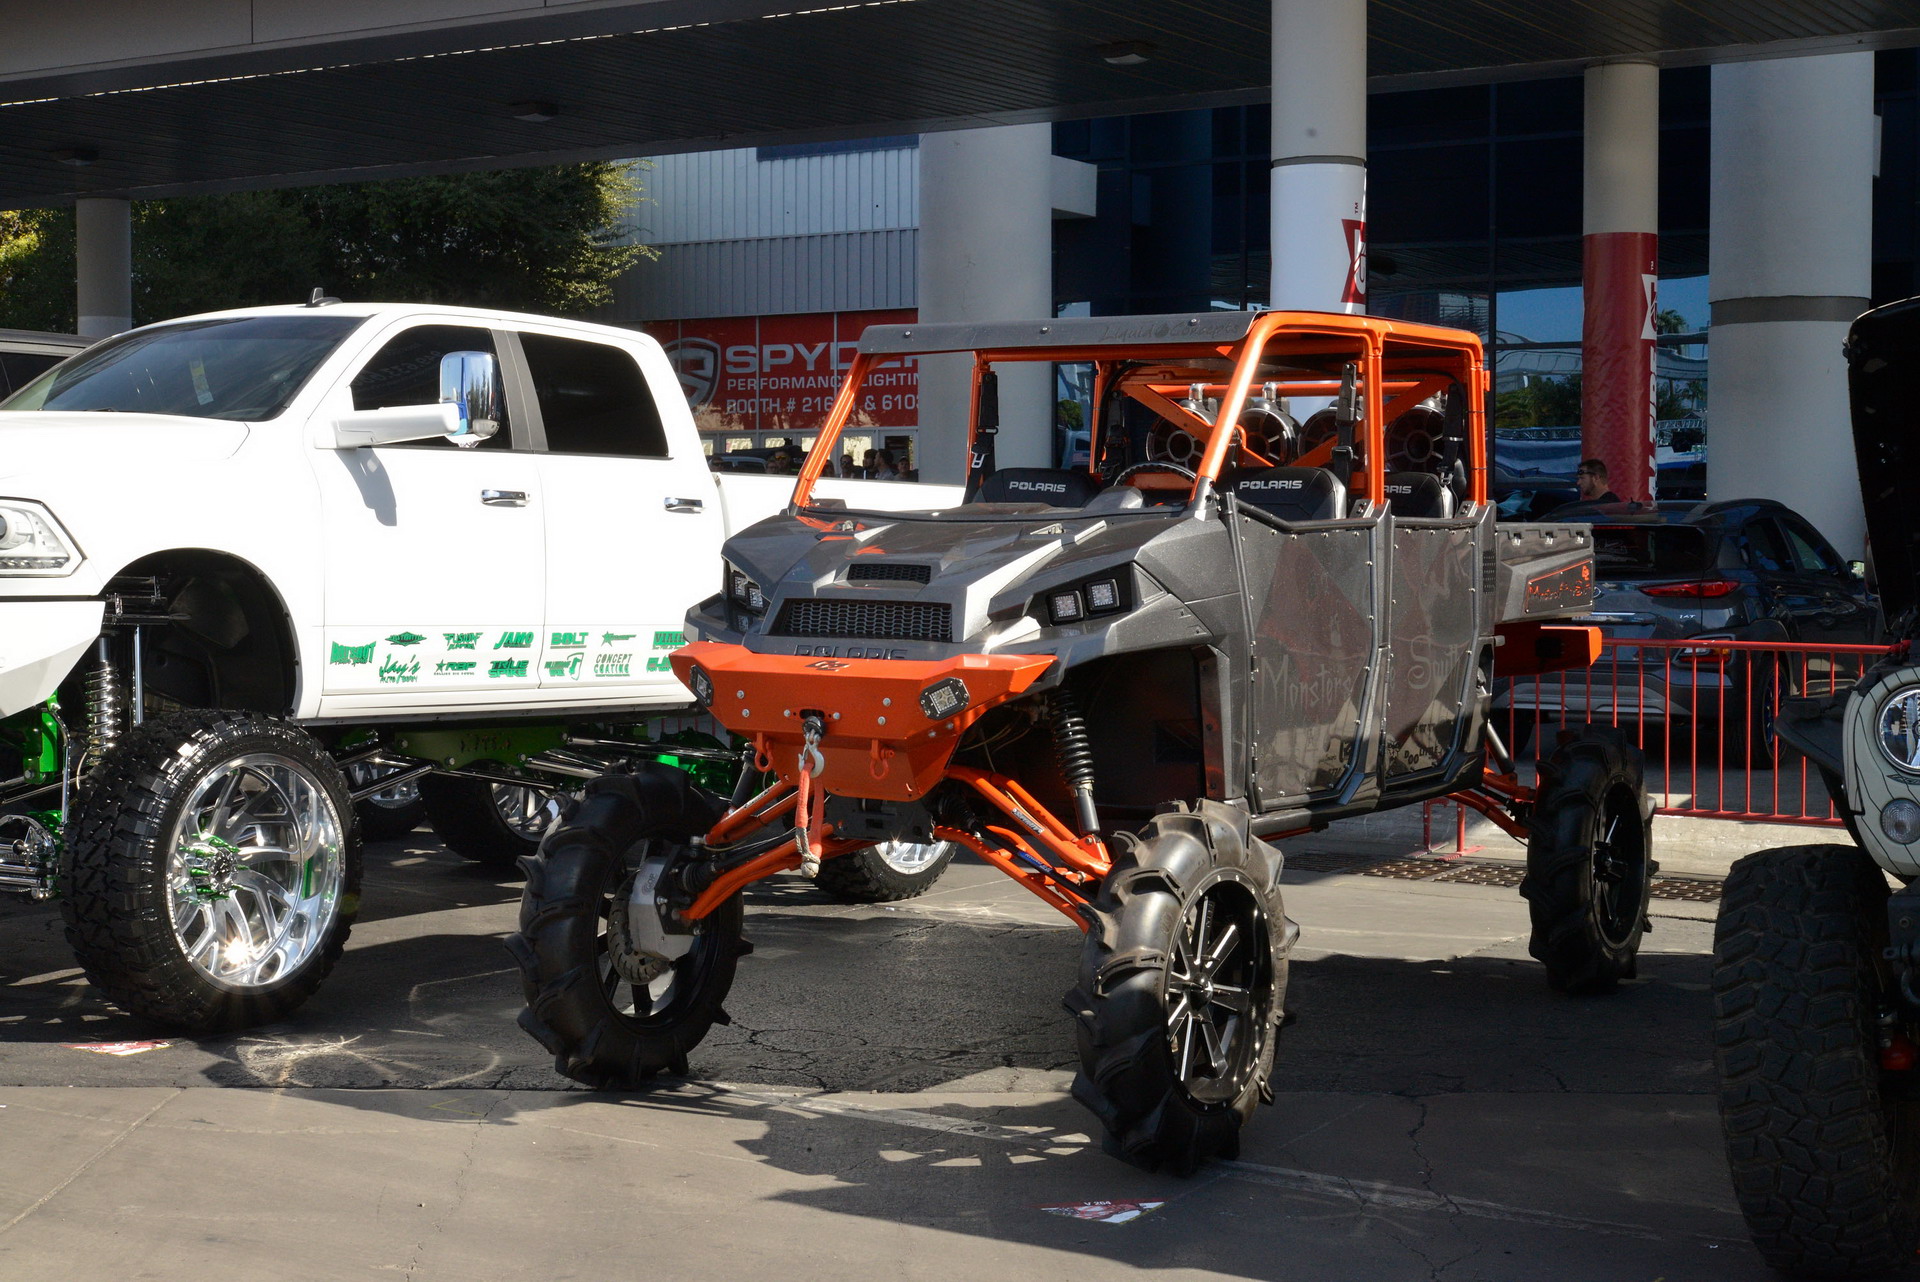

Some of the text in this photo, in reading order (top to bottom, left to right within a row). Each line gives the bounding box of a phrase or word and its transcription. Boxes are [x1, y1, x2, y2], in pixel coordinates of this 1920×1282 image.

[725, 341, 919, 374] SPYD
[727, 375, 848, 391] PERFORMANC
[726, 397, 781, 415] BOOTH
[864, 395, 877, 411] &
[882, 394, 919, 410] 610
[1009, 481, 1067, 493] POLARIS
[1239, 480, 1303, 490] POLARIS
[1383, 485, 1412, 494] ARIS
[493, 631, 534, 649] JAMO
[551, 632, 589, 645] BOLT
[596, 653, 633, 664] CONCEPT
[379, 653, 421, 681] Jay's
[445, 662, 477, 671] RBP
[594, 663, 630, 674] COATING
